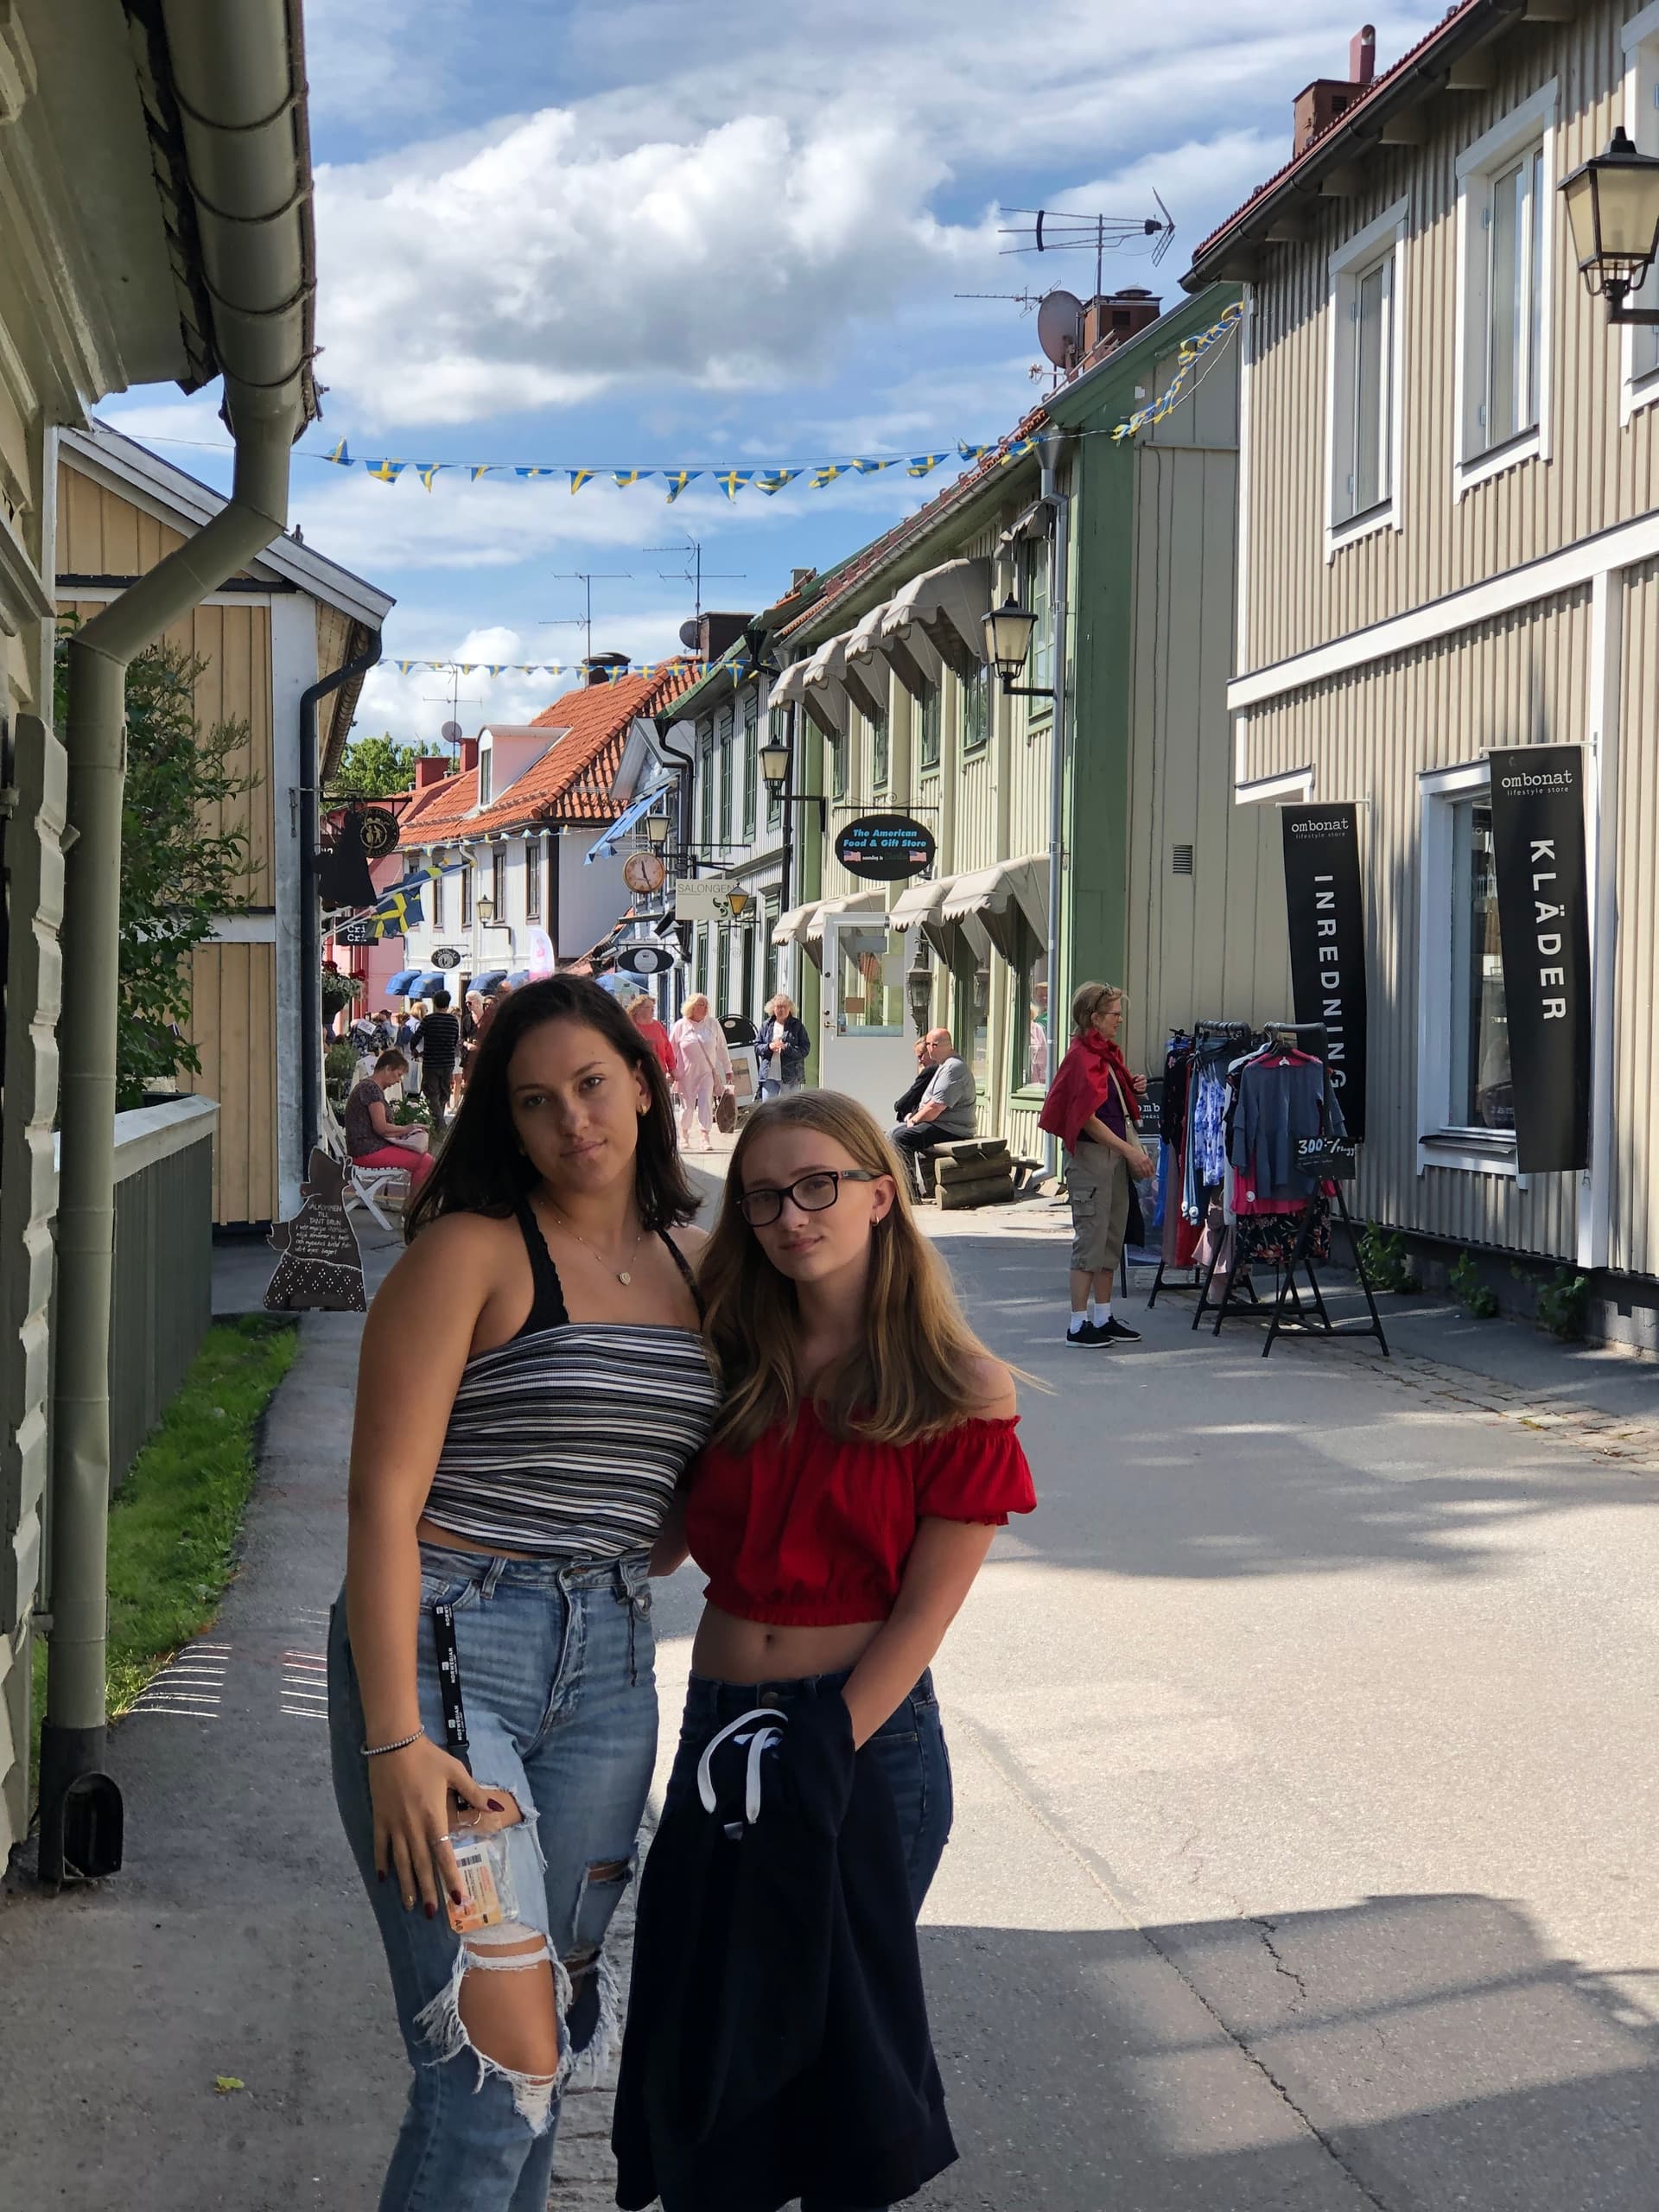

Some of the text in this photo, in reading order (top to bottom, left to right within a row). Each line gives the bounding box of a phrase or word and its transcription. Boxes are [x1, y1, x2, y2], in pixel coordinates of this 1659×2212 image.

[1501, 768, 1573, 787] ombonat
[1507, 785, 1570, 797] lifestyle store
[853, 829, 918, 837] The American
[1291, 817, 1349, 833] ombonat
[843, 839, 927, 848] Food & Gift Store
[677, 883, 734, 893] SALONGEN
[347, 925, 366, 933] Cri
[1529, 839, 1568, 1020] KLÄDER
[1313, 874, 1347, 1089] INREDNING
[448, 1647, 457, 1684] NORWEGIAN
[453, 1705, 462, 1741] NORWEGIAN
